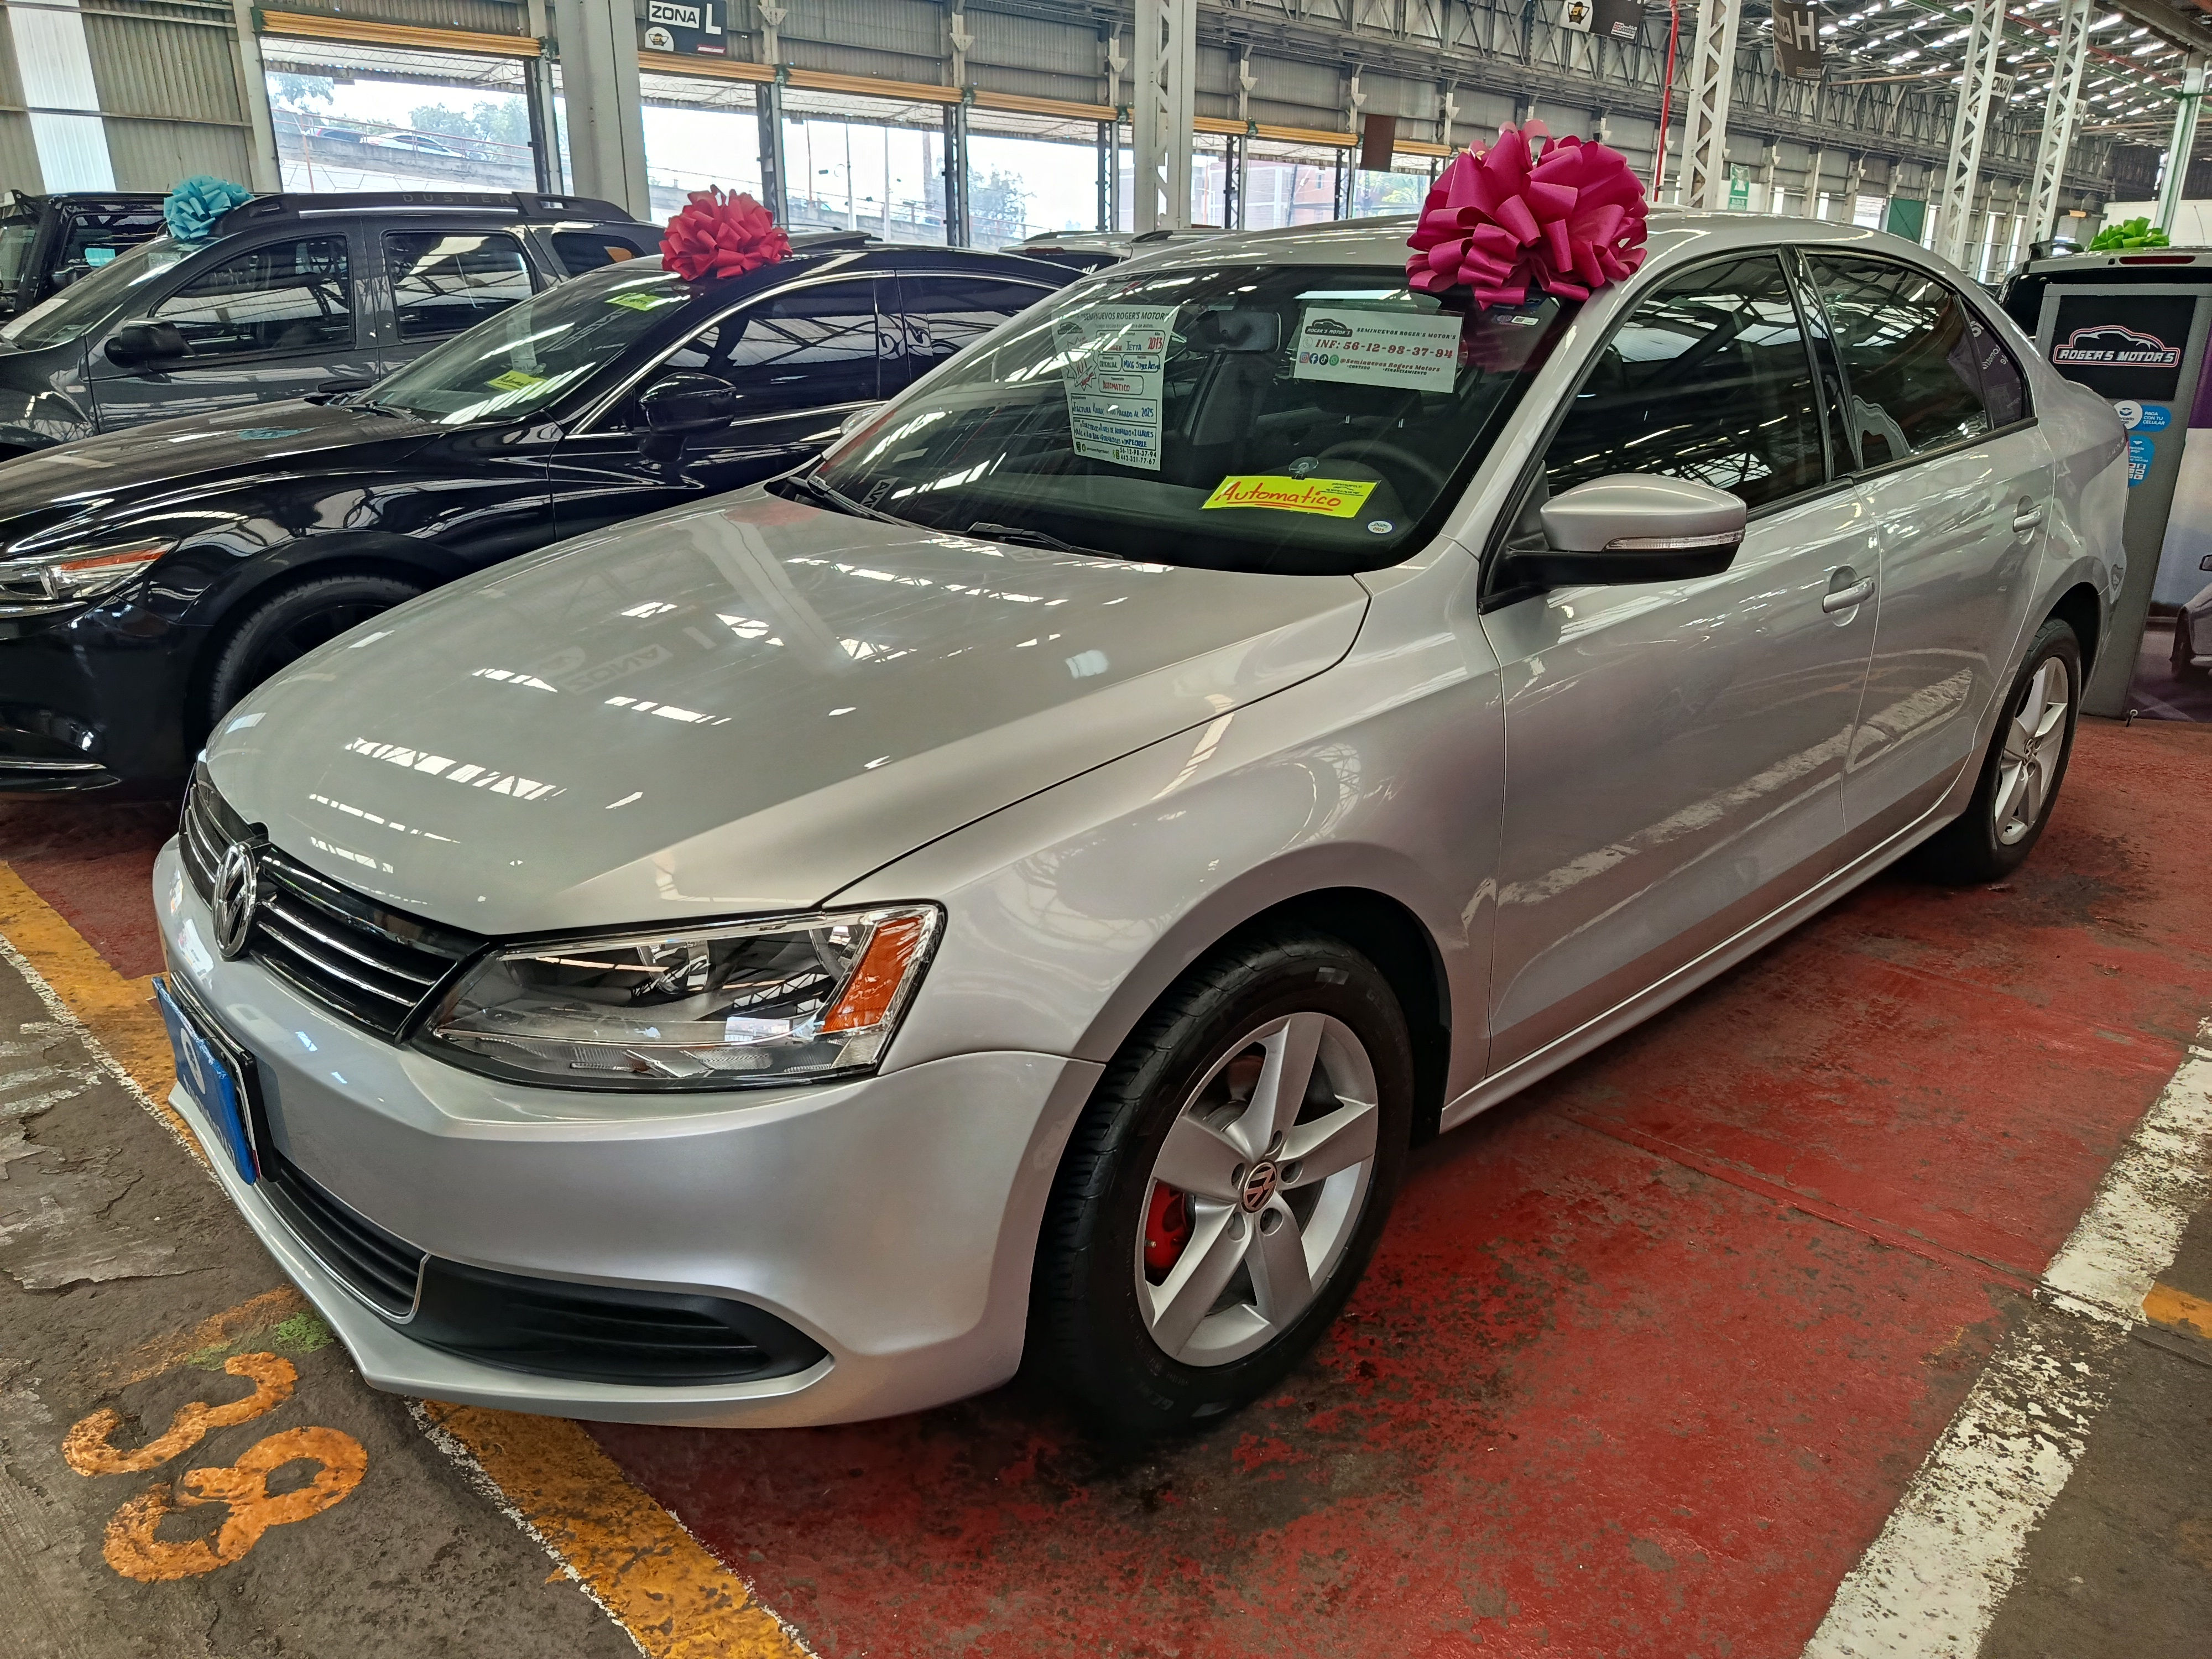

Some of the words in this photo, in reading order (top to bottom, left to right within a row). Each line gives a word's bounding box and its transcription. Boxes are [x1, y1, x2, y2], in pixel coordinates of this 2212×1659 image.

[651, 5, 697, 24] ZONA
[706, 3, 721, 34] L
[1793, 11, 1815, 51] H
[403, 194, 511, 204] DUSTER
[1126, 341, 1142, 351] JETTA
[1148, 337, 1163, 349] 2013
[1315, 339, 1340, 349] INF:
[1343, 341, 1453, 359] 56-12-98-37-94
[2058, 348, 2114, 361] ROGER'S
[2116, 350, 2176, 363] MOTOR'S
[1340, 358, 1387, 367] @Seminuevos
[1388, 362, 1413, 371] Rogers
[1415, 364, 1441, 372] Motors
[1141, 407, 1154, 417] 2025
[1214, 481, 1342, 507] Automatico
